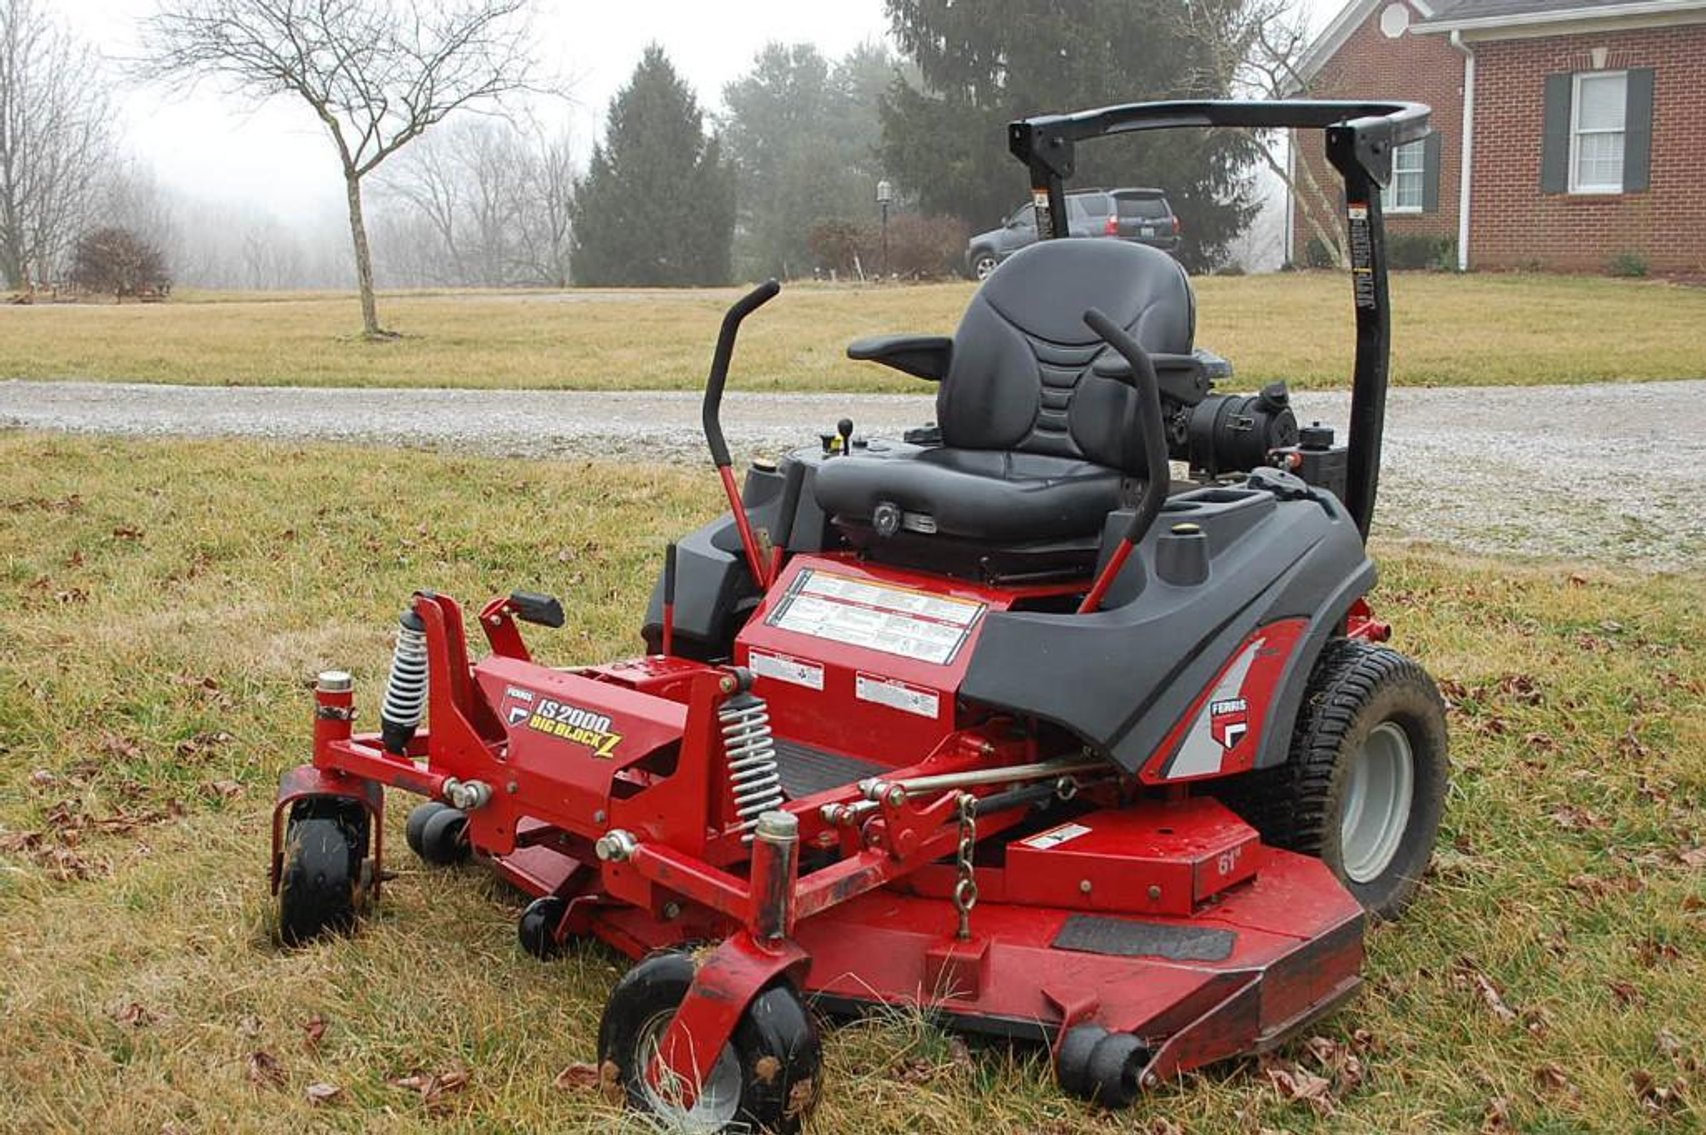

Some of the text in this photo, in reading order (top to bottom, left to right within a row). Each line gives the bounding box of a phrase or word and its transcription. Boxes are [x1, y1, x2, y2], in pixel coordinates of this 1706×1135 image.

[536, 699, 611, 733] IS 2000
[1212, 700, 1247, 716] FERRIS
[529, 715, 623, 758] BIG BLOCK Z
